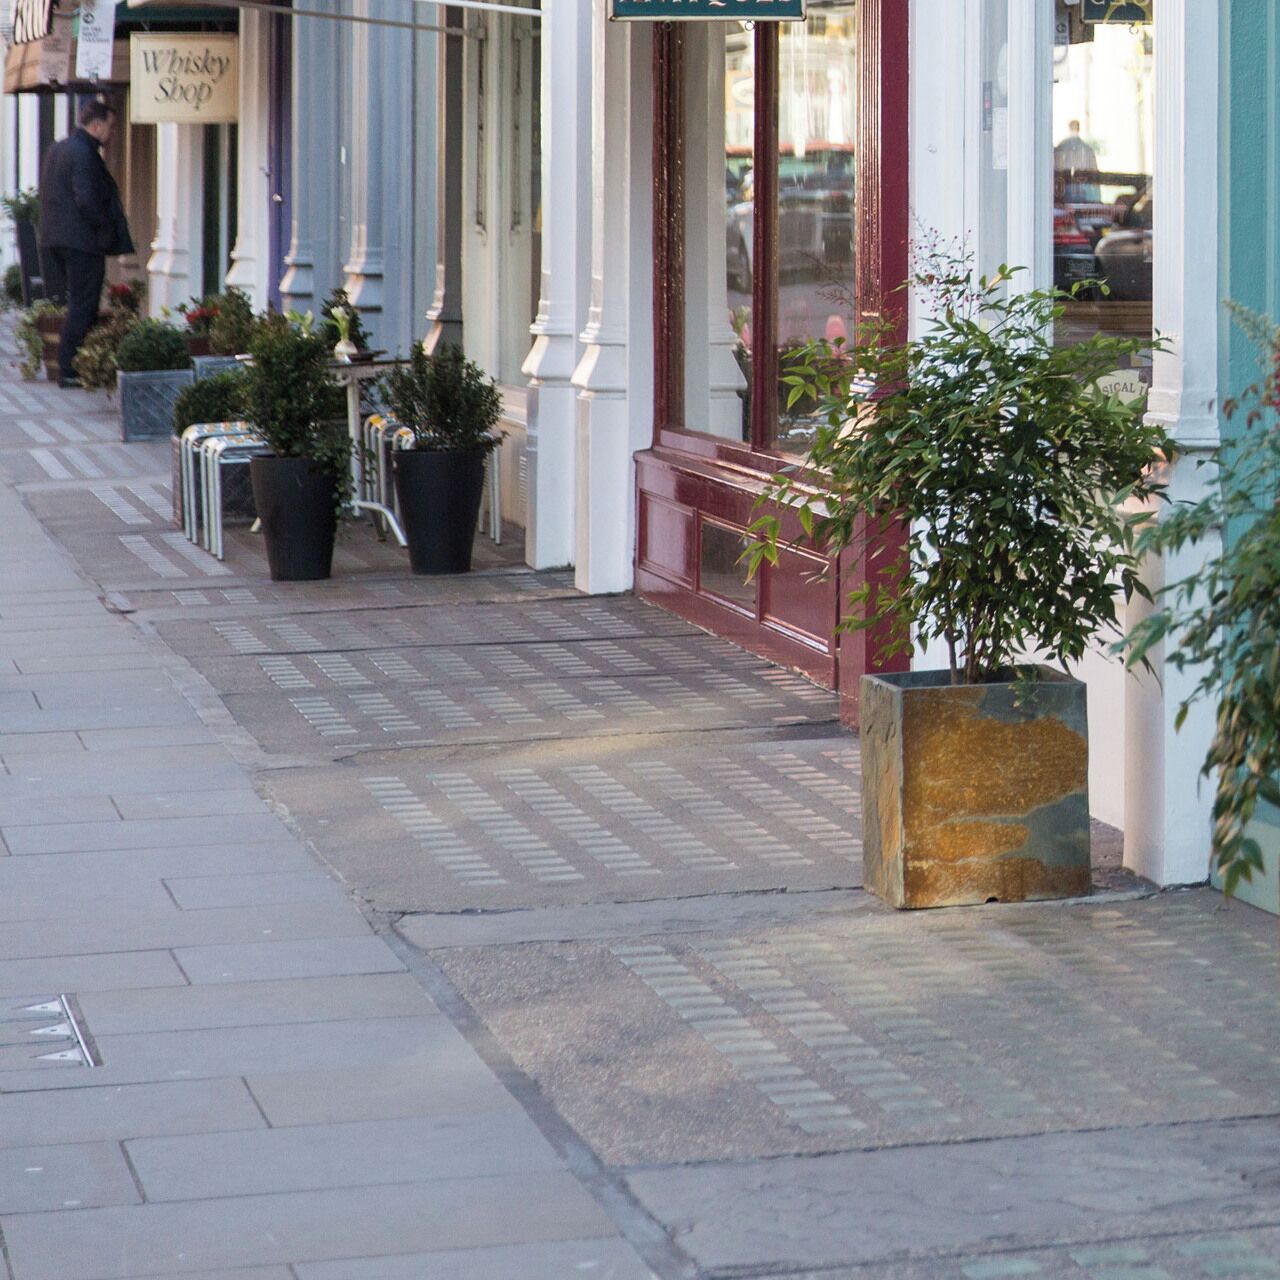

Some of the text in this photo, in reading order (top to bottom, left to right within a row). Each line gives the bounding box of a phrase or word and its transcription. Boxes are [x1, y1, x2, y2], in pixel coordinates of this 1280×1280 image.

[142, 47, 232, 84] Whisky
[154, 75, 214, 111] Shop
[1102, 381, 1137, 396] SICAL
